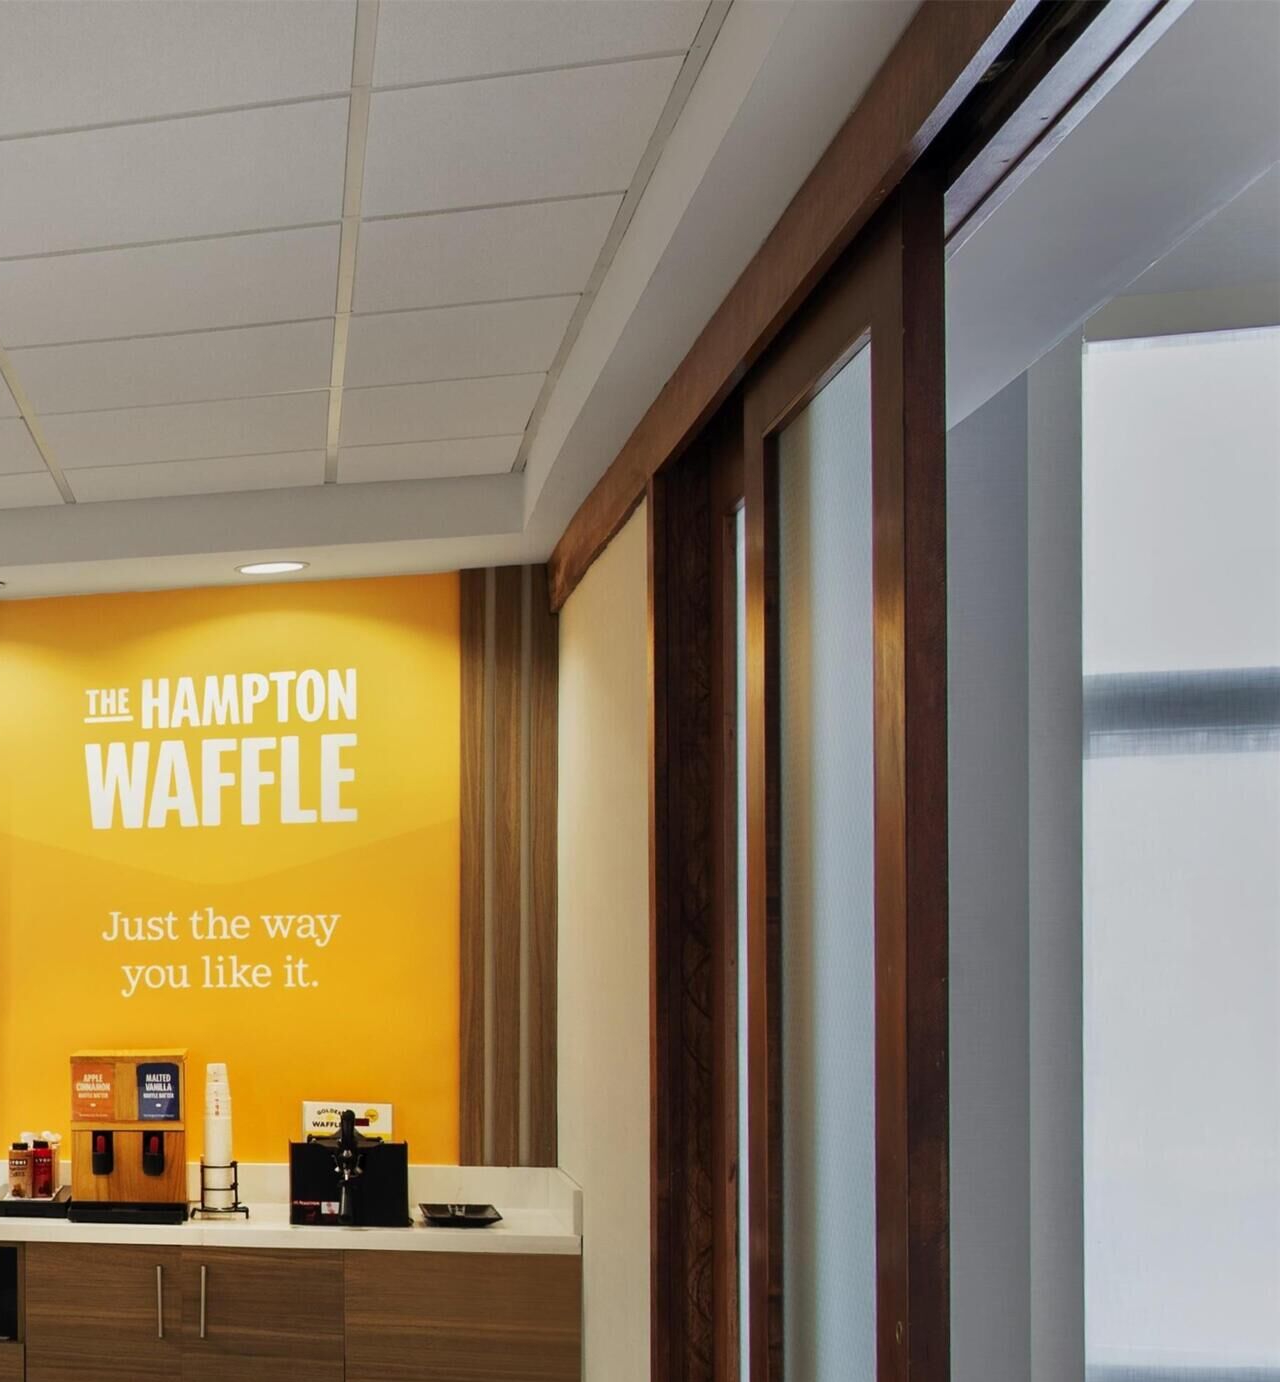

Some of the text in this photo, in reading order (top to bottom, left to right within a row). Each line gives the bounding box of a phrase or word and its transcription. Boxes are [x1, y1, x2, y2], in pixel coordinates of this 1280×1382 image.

[86, 668, 357, 729] THE HAMPTON
[84, 733, 358, 829] WAFFLE
[102, 907, 341, 947] Just the way
[121, 954, 319, 998] you like it.
[145, 1073, 171, 1083] MALTED
[145, 1082, 173, 1092] VANILLA
